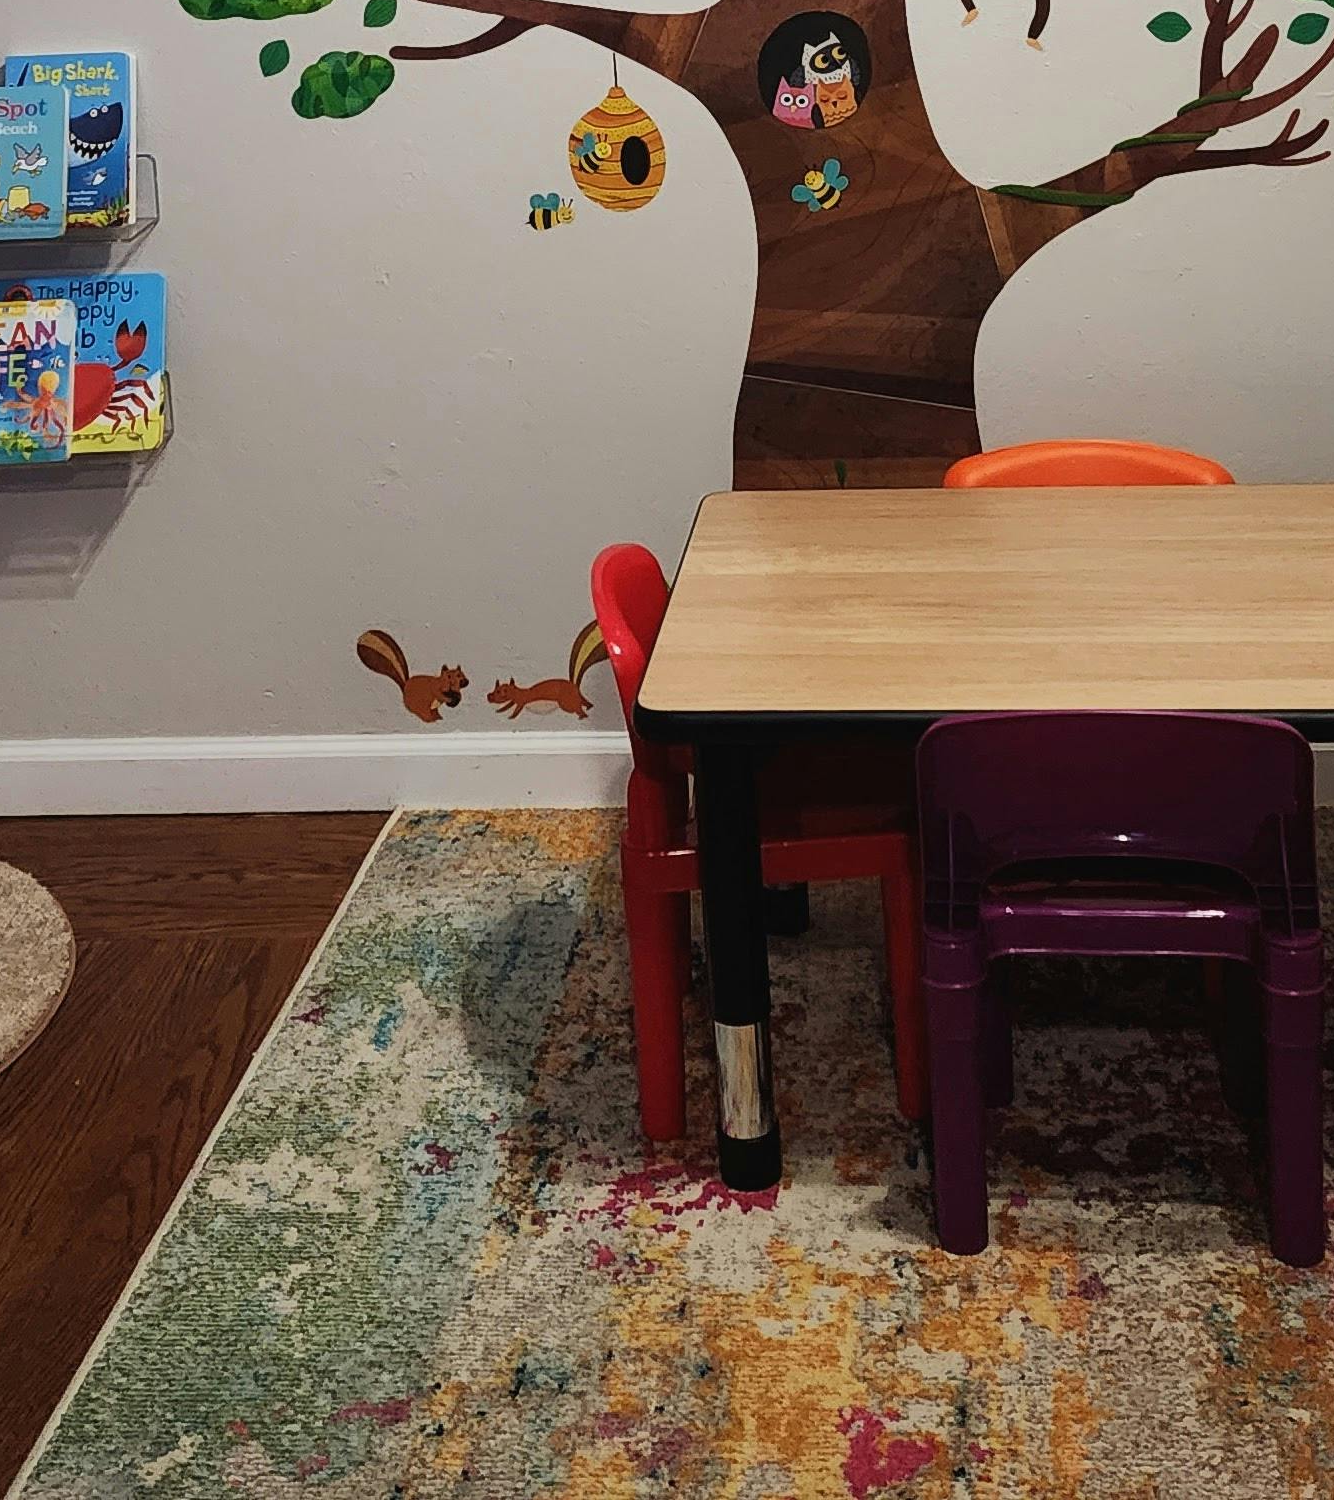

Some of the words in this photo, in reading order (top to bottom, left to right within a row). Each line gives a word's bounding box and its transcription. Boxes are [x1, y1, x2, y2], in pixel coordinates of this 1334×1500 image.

[31, 64, 62, 85] Big
[74, 85, 110, 97] Shark
[37, 285, 64, 302] The
